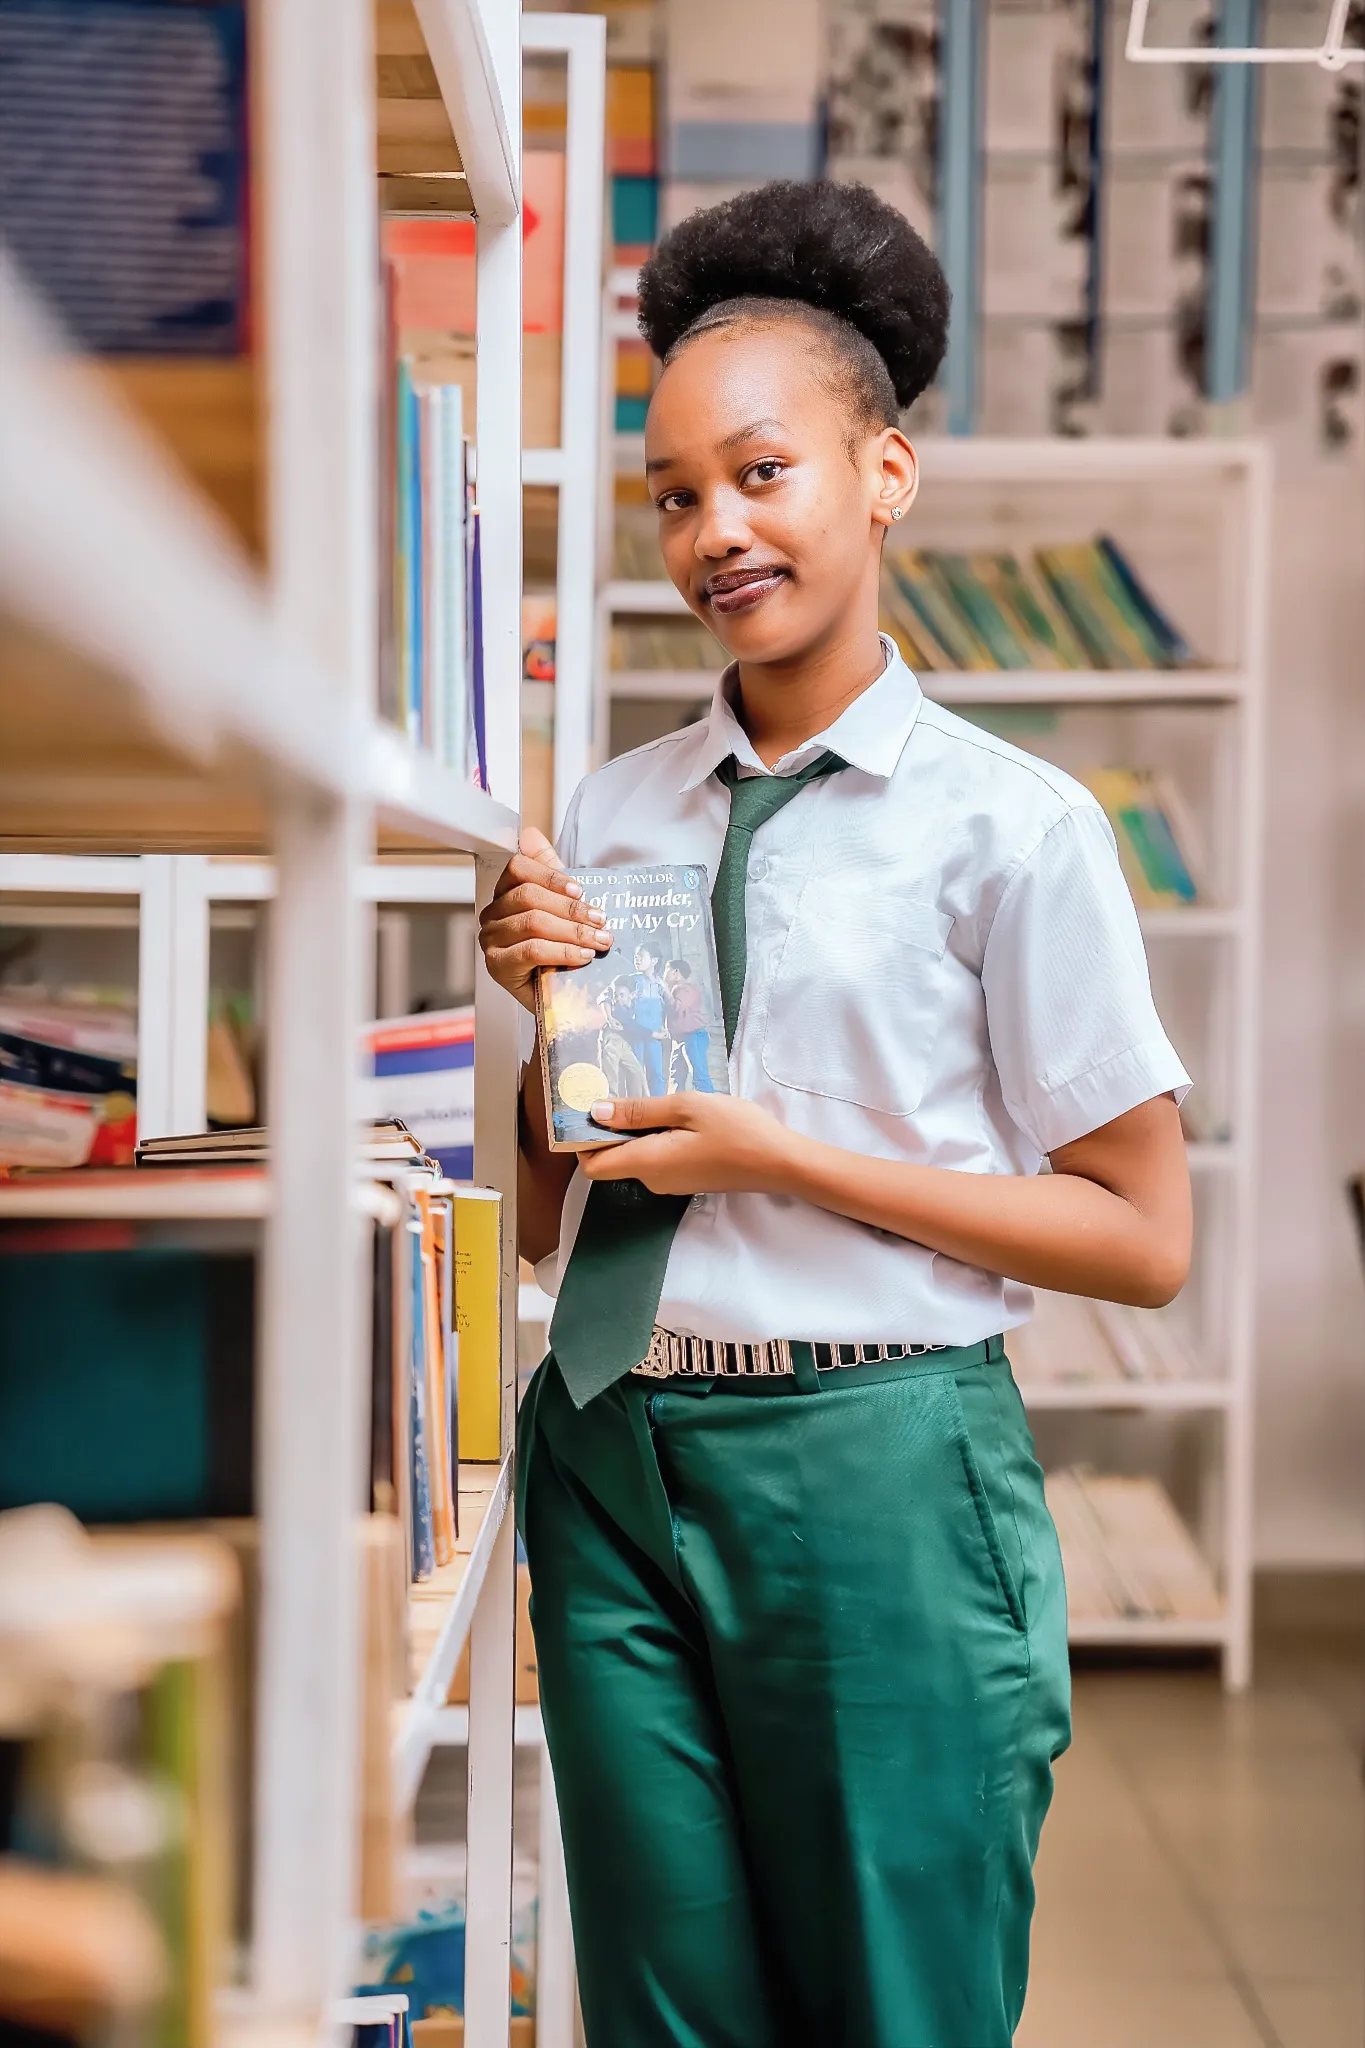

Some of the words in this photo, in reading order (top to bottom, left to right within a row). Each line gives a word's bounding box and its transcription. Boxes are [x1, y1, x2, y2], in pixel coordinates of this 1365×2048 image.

[607, 875, 621, 885] D.
[623, 873, 674, 885] TAYLOR
[589, 891, 610, 911] of
[612, 888, 692, 908] Thunder,
[631, 913, 663, 934] My
[666, 912, 700, 932] Cry
